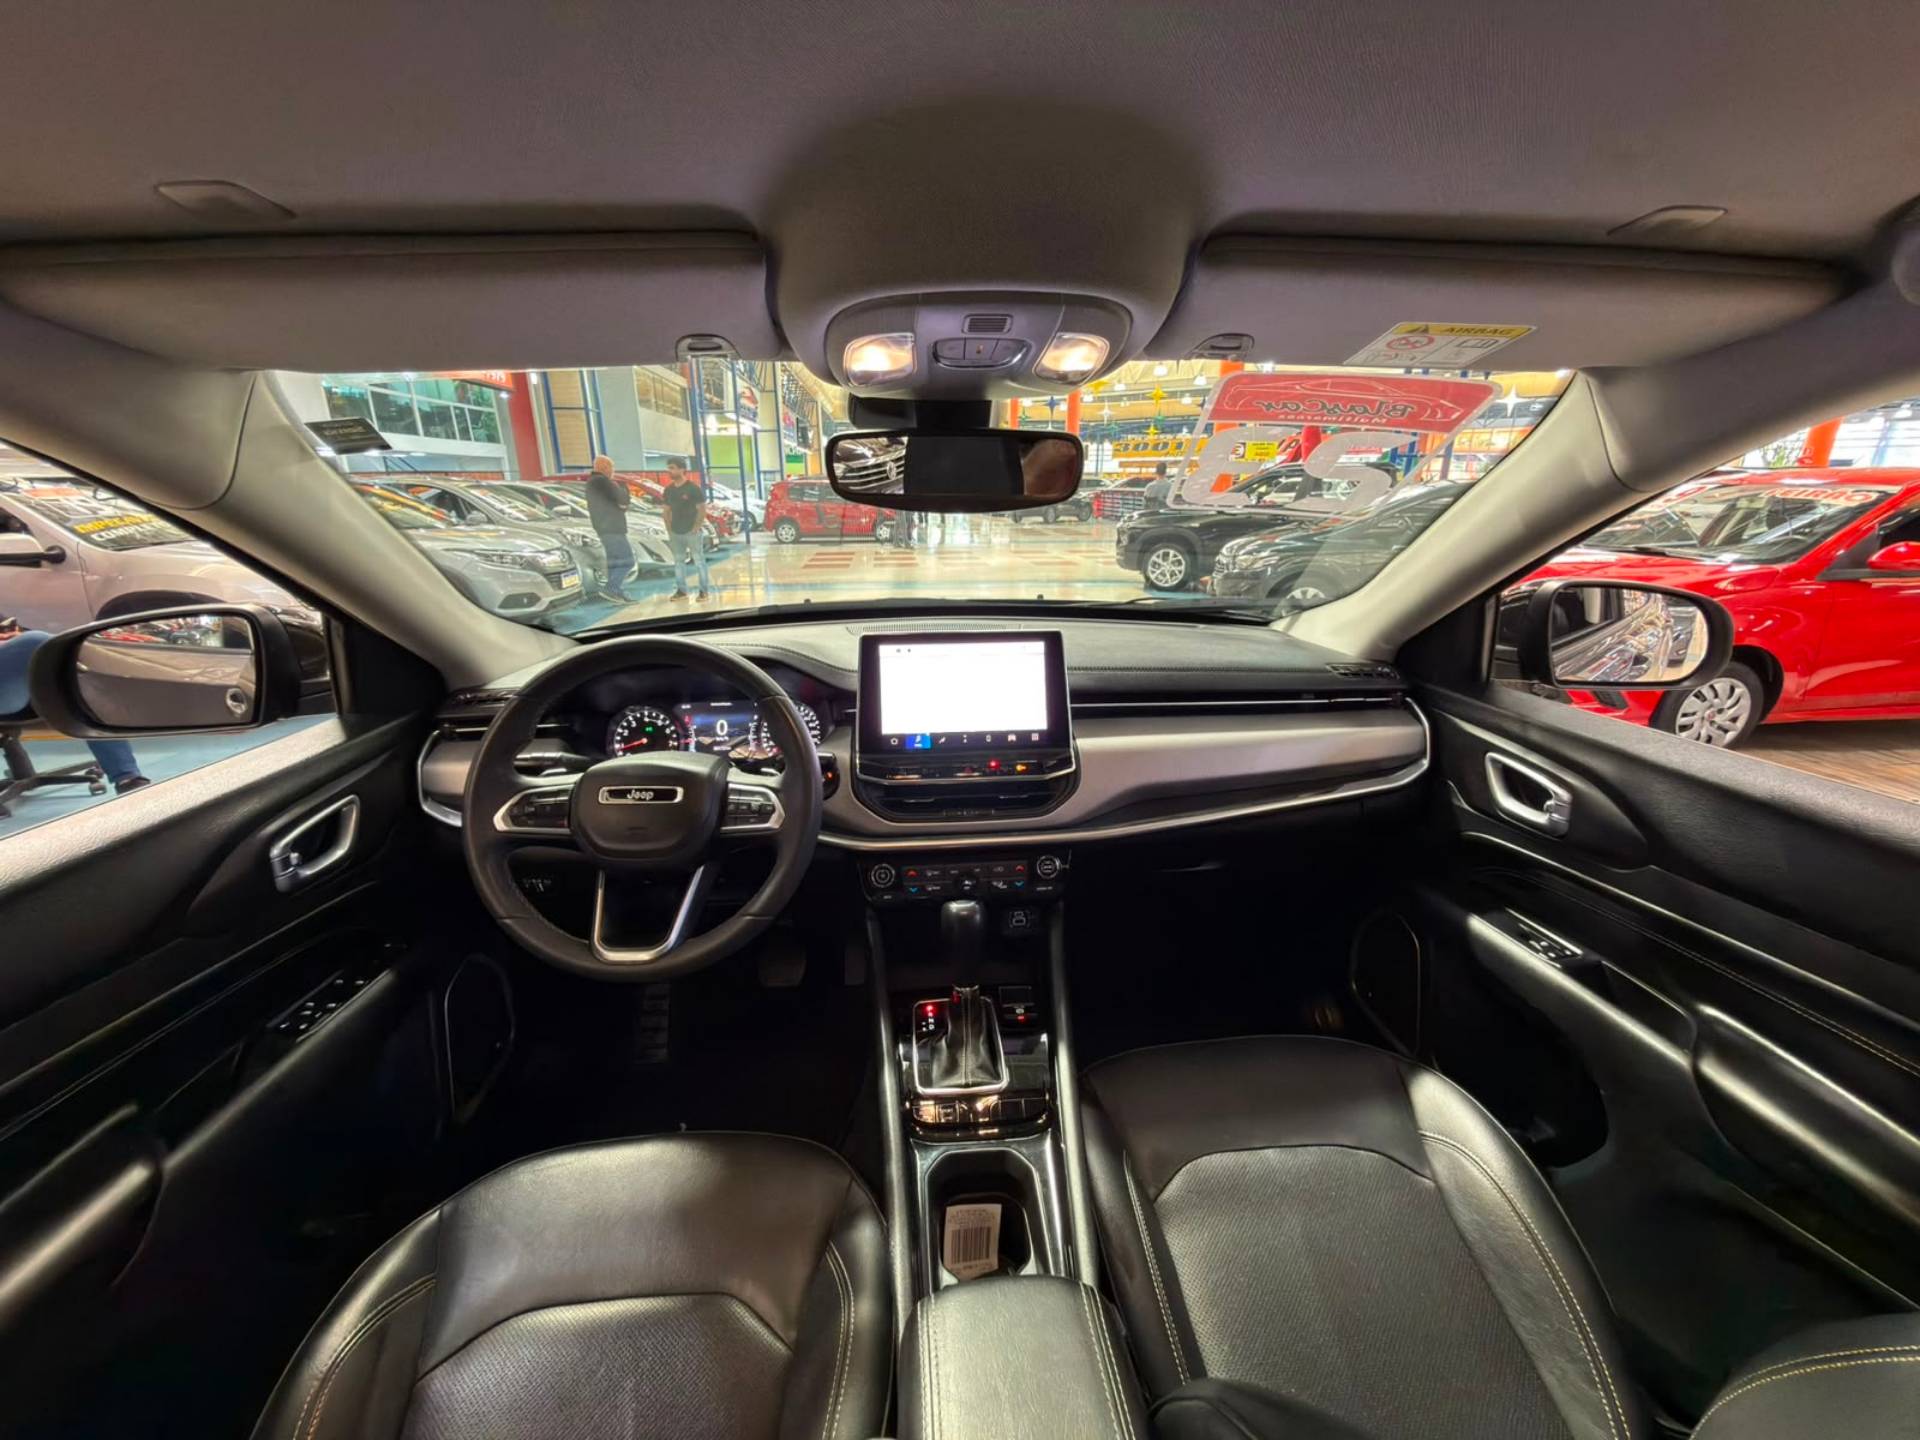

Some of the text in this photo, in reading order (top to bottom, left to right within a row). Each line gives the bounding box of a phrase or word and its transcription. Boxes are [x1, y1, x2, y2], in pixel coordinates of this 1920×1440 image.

[1442, 327, 1515, 335] AIRBAG
[716, 719, 728, 736] 0
[626, 789, 655, 800] Jeep
